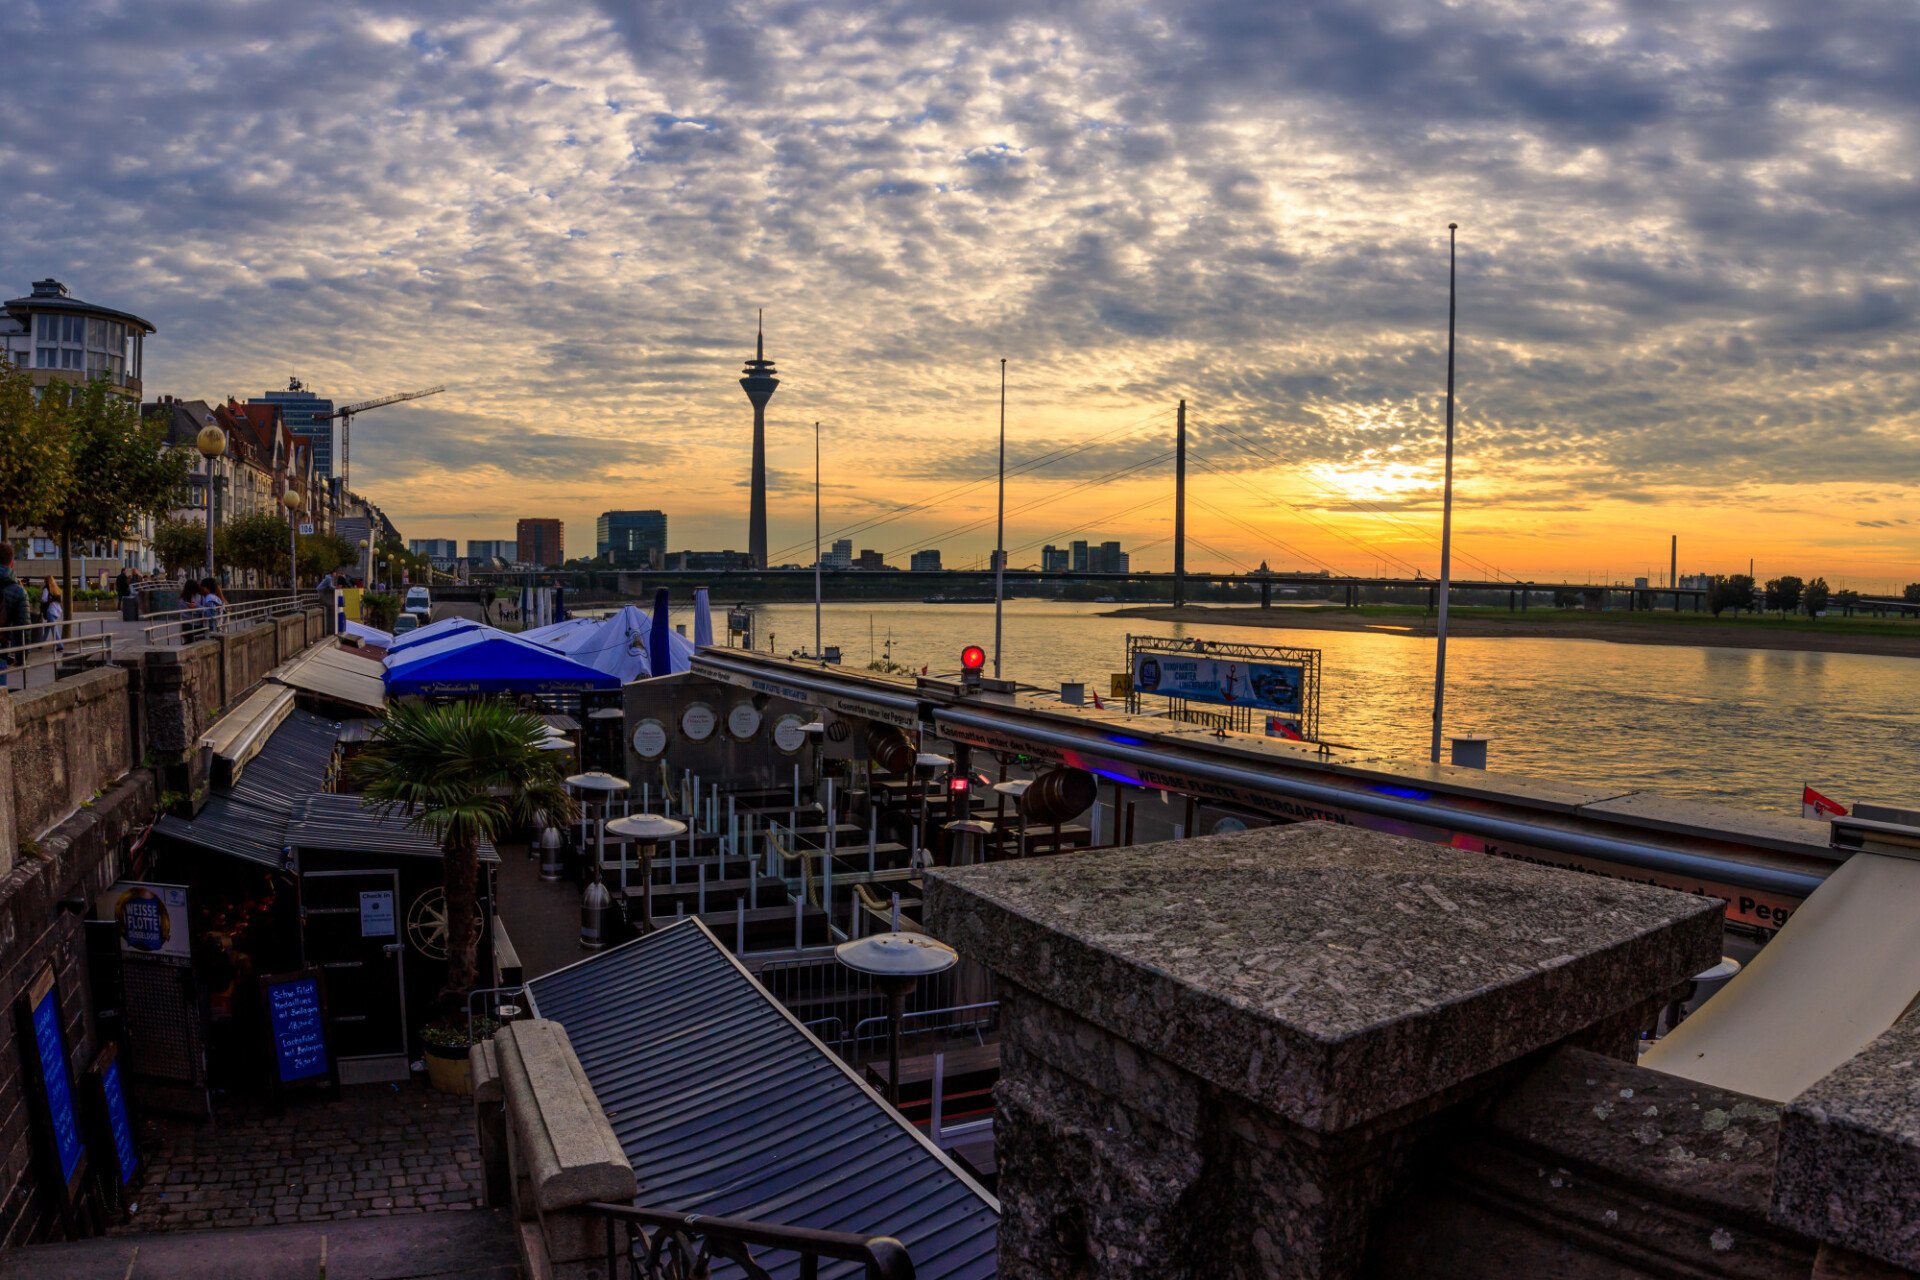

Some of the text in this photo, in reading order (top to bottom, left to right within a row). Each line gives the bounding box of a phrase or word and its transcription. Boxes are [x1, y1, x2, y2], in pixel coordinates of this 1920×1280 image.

[300, 524, 313, 533] 106
[1174, 671, 1197, 681] CHARTER
[939, 724, 986, 744] Kasematten
[987, 736, 1009, 748] unter
[1010, 740, 1024, 751] der
[1137, 768, 1186, 789] WEISSE
[1187, 778, 1240, 800] FLOTTE
[1249, 792, 1346, 825] BIERGARTEN
[125, 903, 158, 918] WEISSE
[127, 915, 160, 932] FLOTTE
